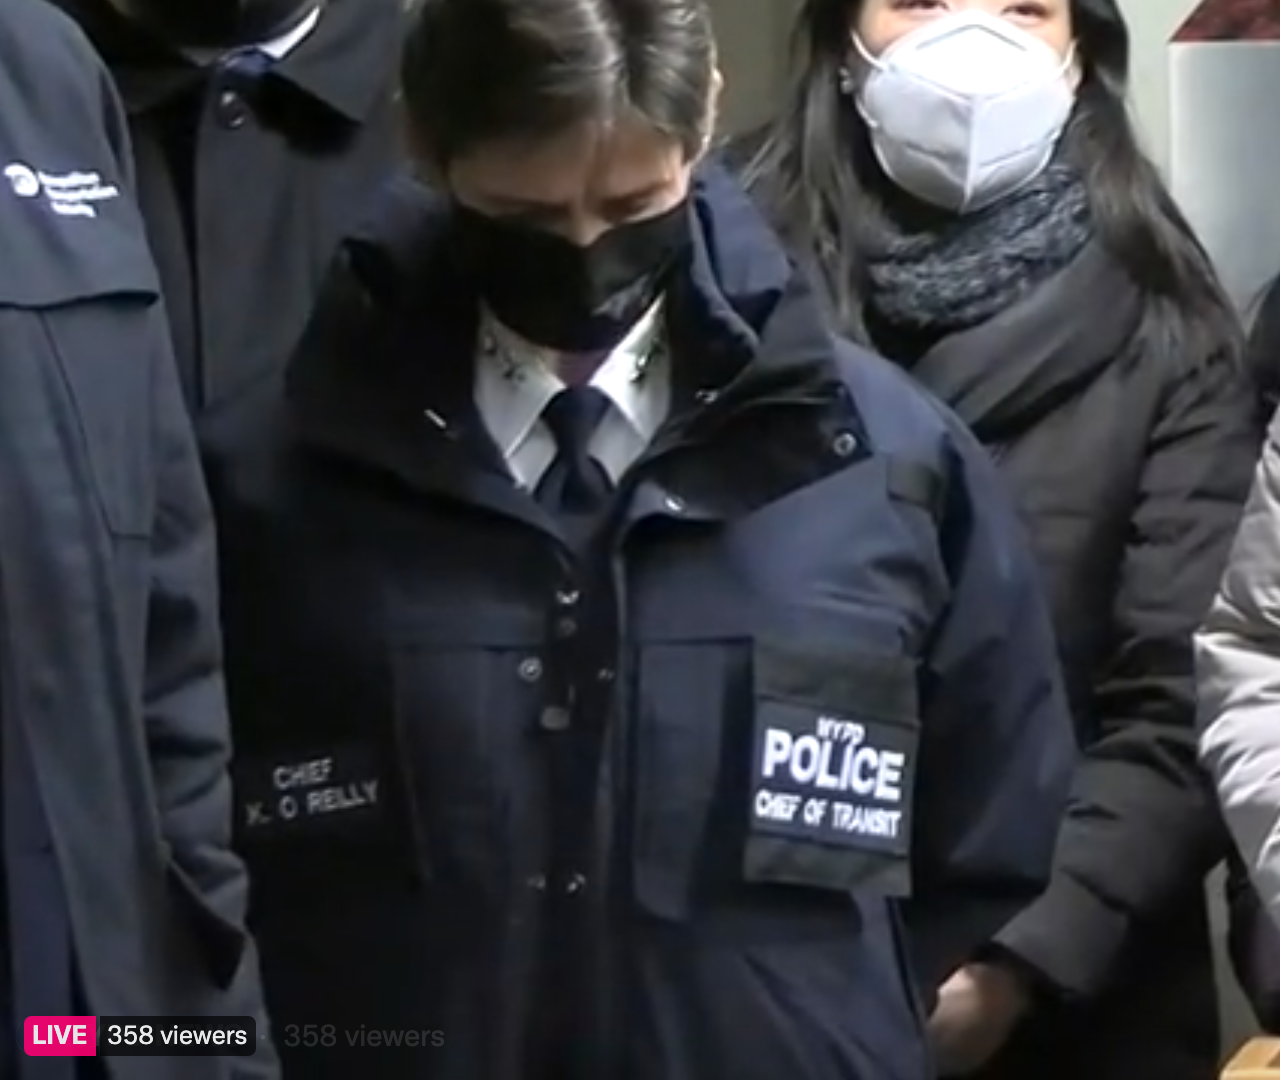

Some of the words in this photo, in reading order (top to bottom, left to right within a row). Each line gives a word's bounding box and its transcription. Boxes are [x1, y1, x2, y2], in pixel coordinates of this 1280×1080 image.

[272, 756, 333, 791] CHIEF
[762, 727, 905, 803] POLICE
[755, 788, 802, 821] CHIEF
[803, 796, 828, 827] OF
[831, 801, 902, 839] TRANSIT
